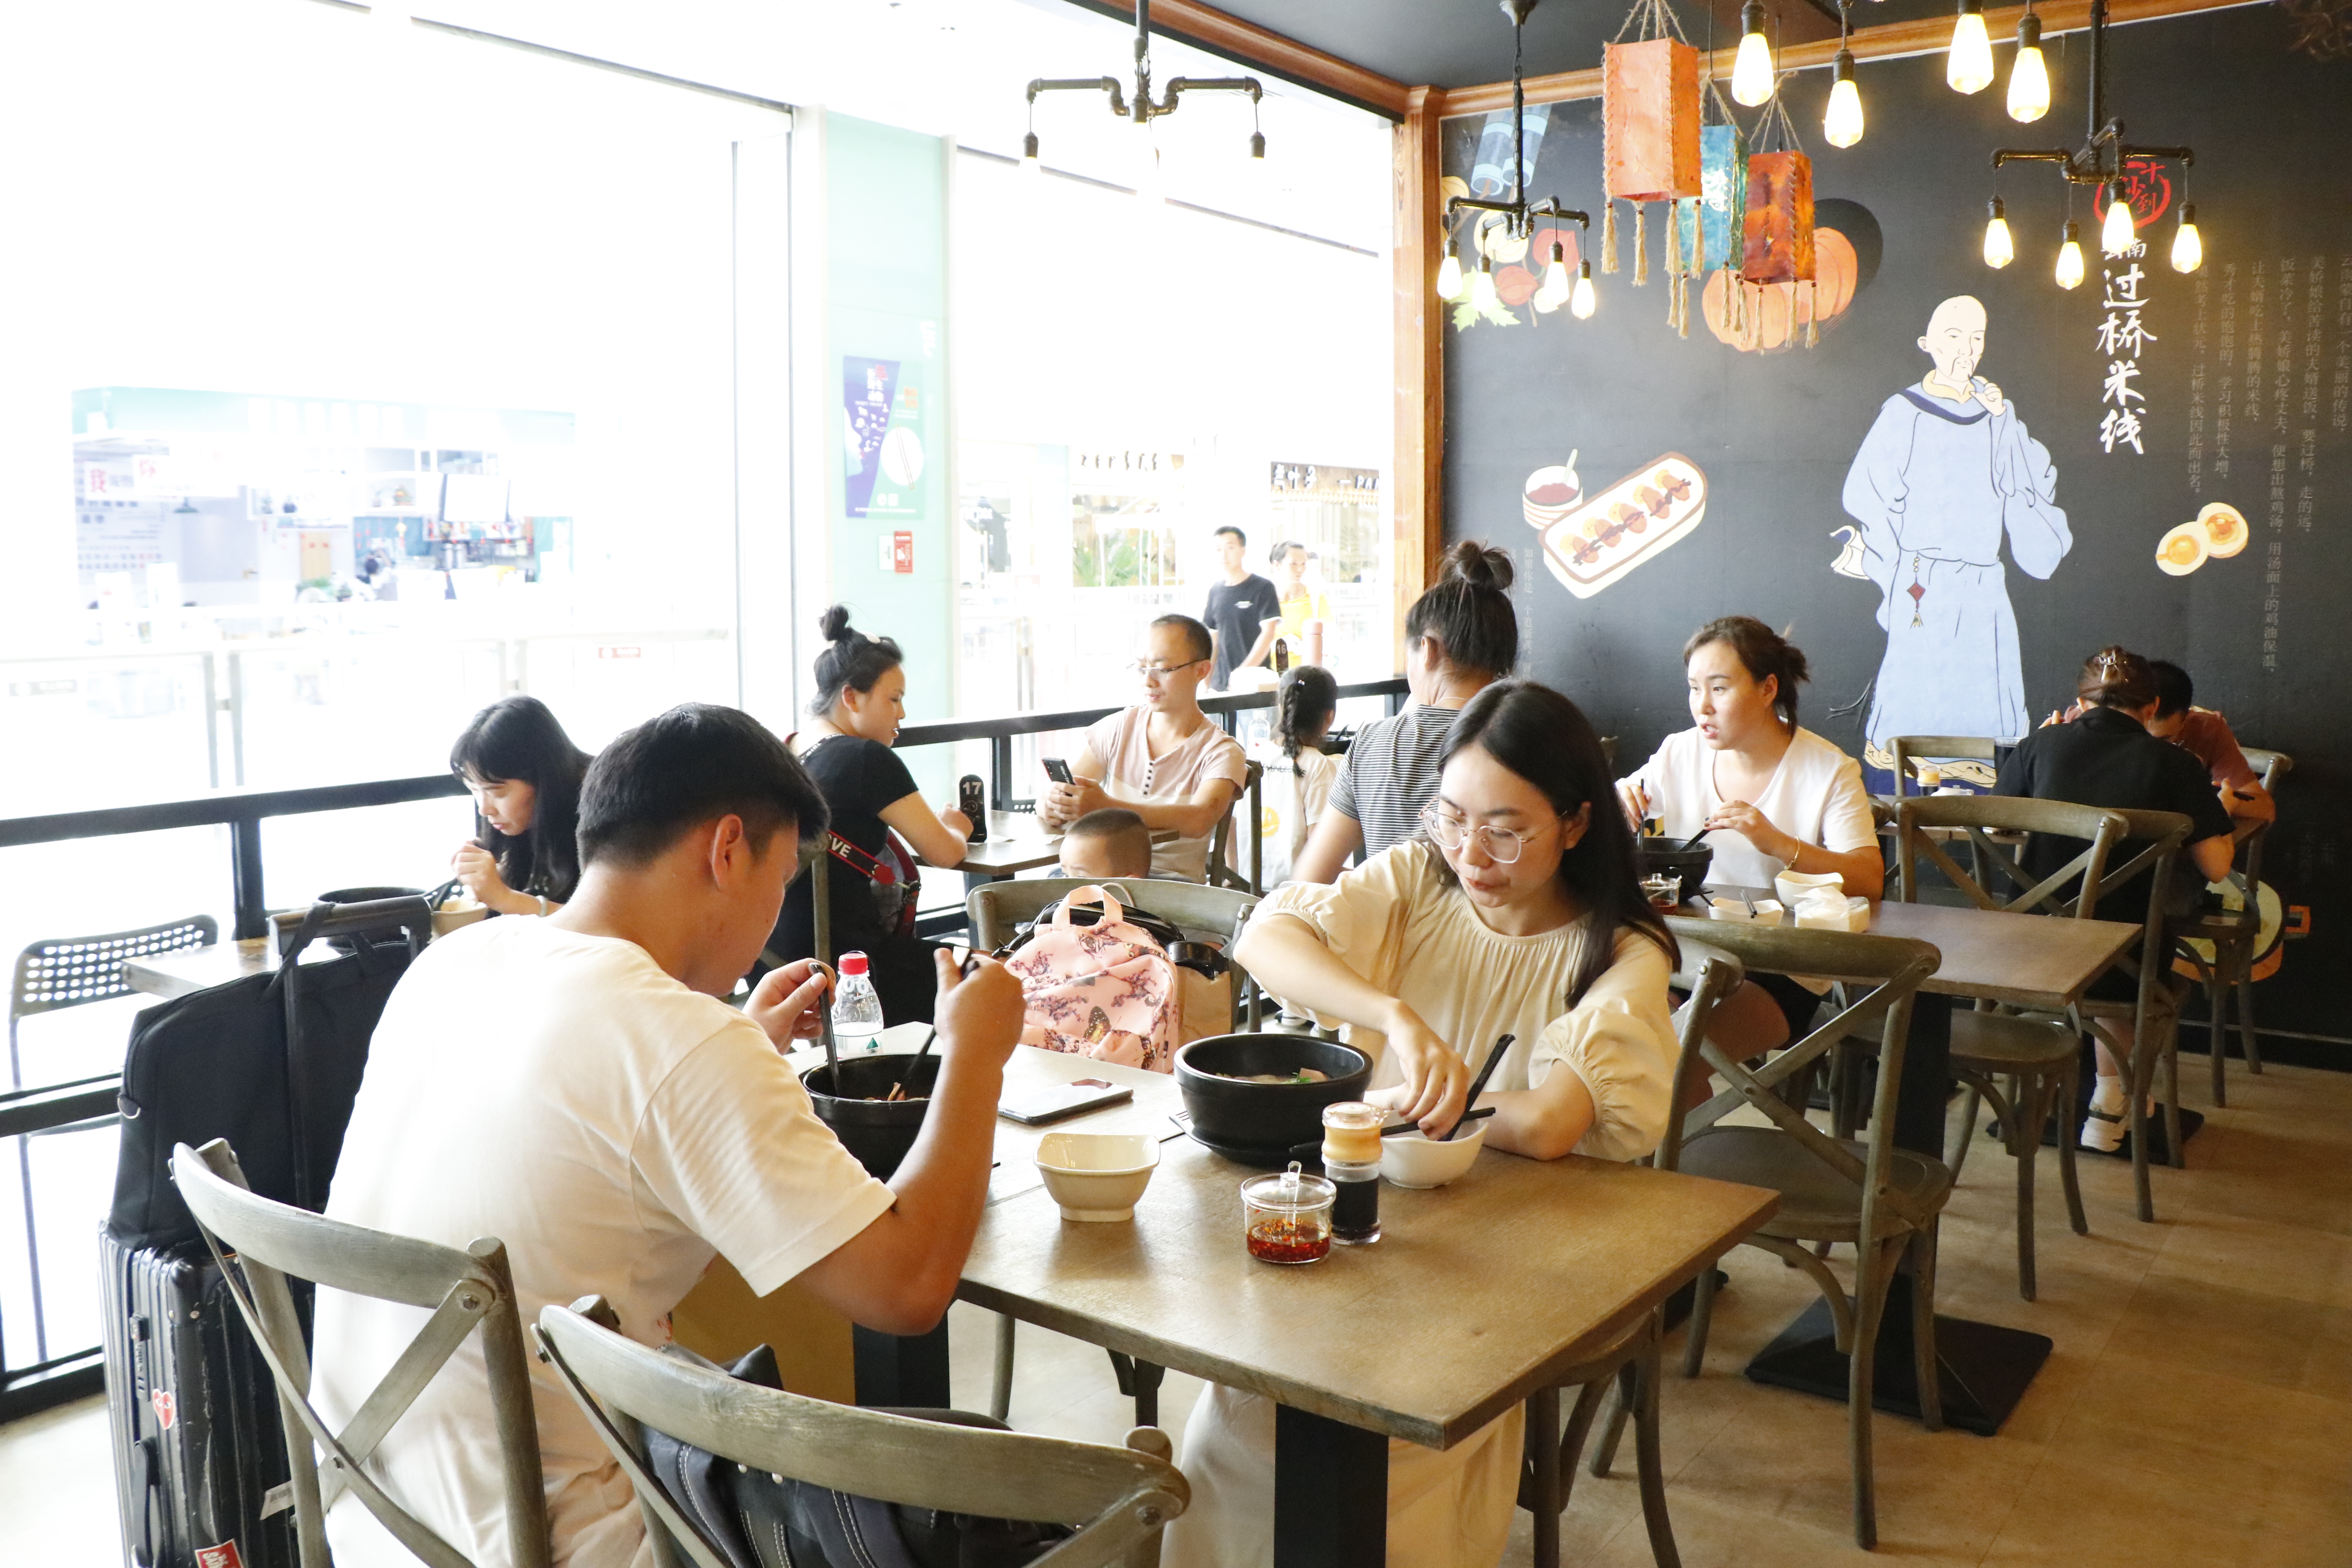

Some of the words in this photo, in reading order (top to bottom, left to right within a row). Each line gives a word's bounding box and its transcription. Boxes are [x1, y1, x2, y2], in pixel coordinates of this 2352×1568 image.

[2095, 264, 2158, 455] 过桥米线
[1276, 643, 1287, 654] 16
[962, 781, 982, 795] 17
[829, 835, 851, 858] VE
